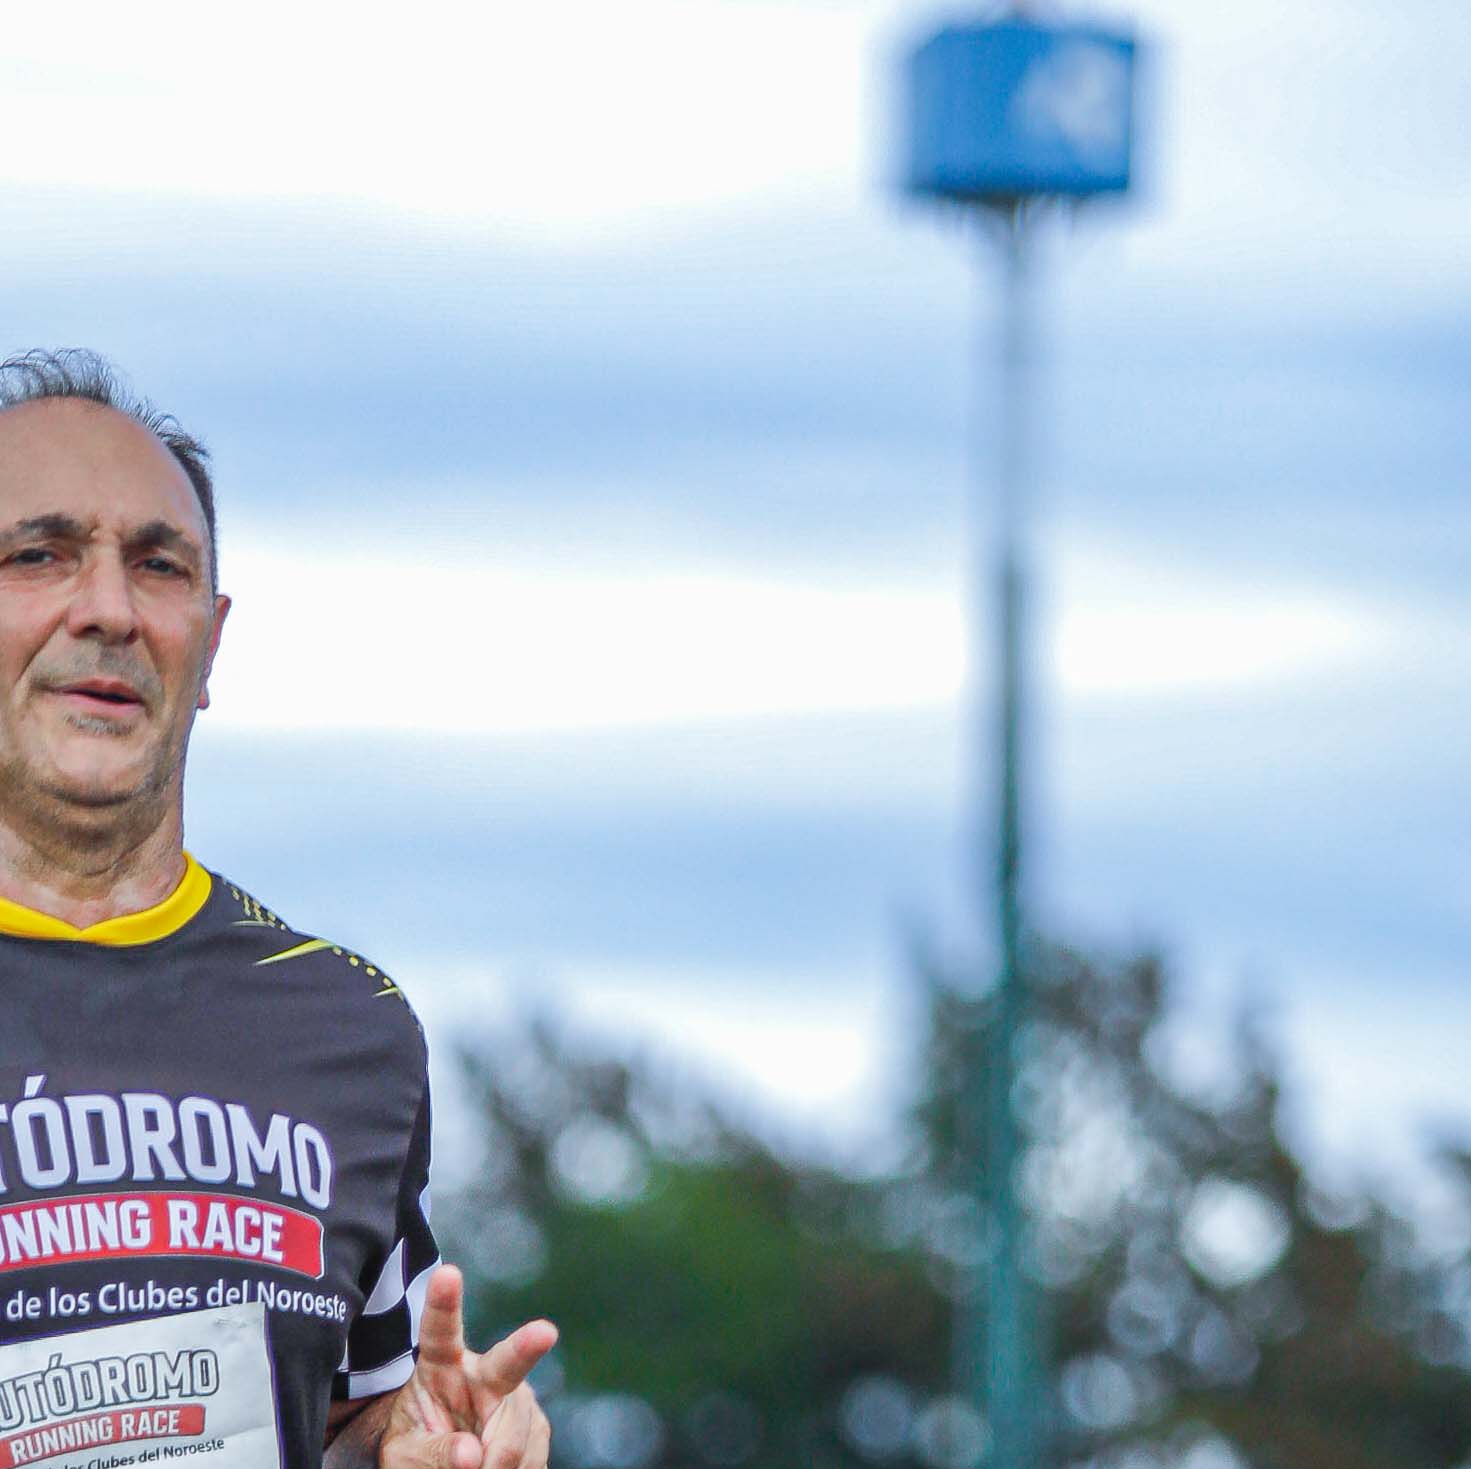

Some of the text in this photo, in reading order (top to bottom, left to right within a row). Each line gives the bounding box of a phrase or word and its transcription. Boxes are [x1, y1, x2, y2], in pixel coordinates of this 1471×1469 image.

[168, 1199, 283, 1263] RACE
[6, 1289, 41, 1320] de
[49, 1286, 90, 1316] los
[98, 1279, 197, 1314] Clubes
[206, 1278, 248, 1308] del
[257, 1280, 347, 1323] Noroeste
[9, 1409, 181, 1466] RUNNING RACE
[138, 1447, 160, 1464] del
[163, 1438, 225, 1460] Noroeste
